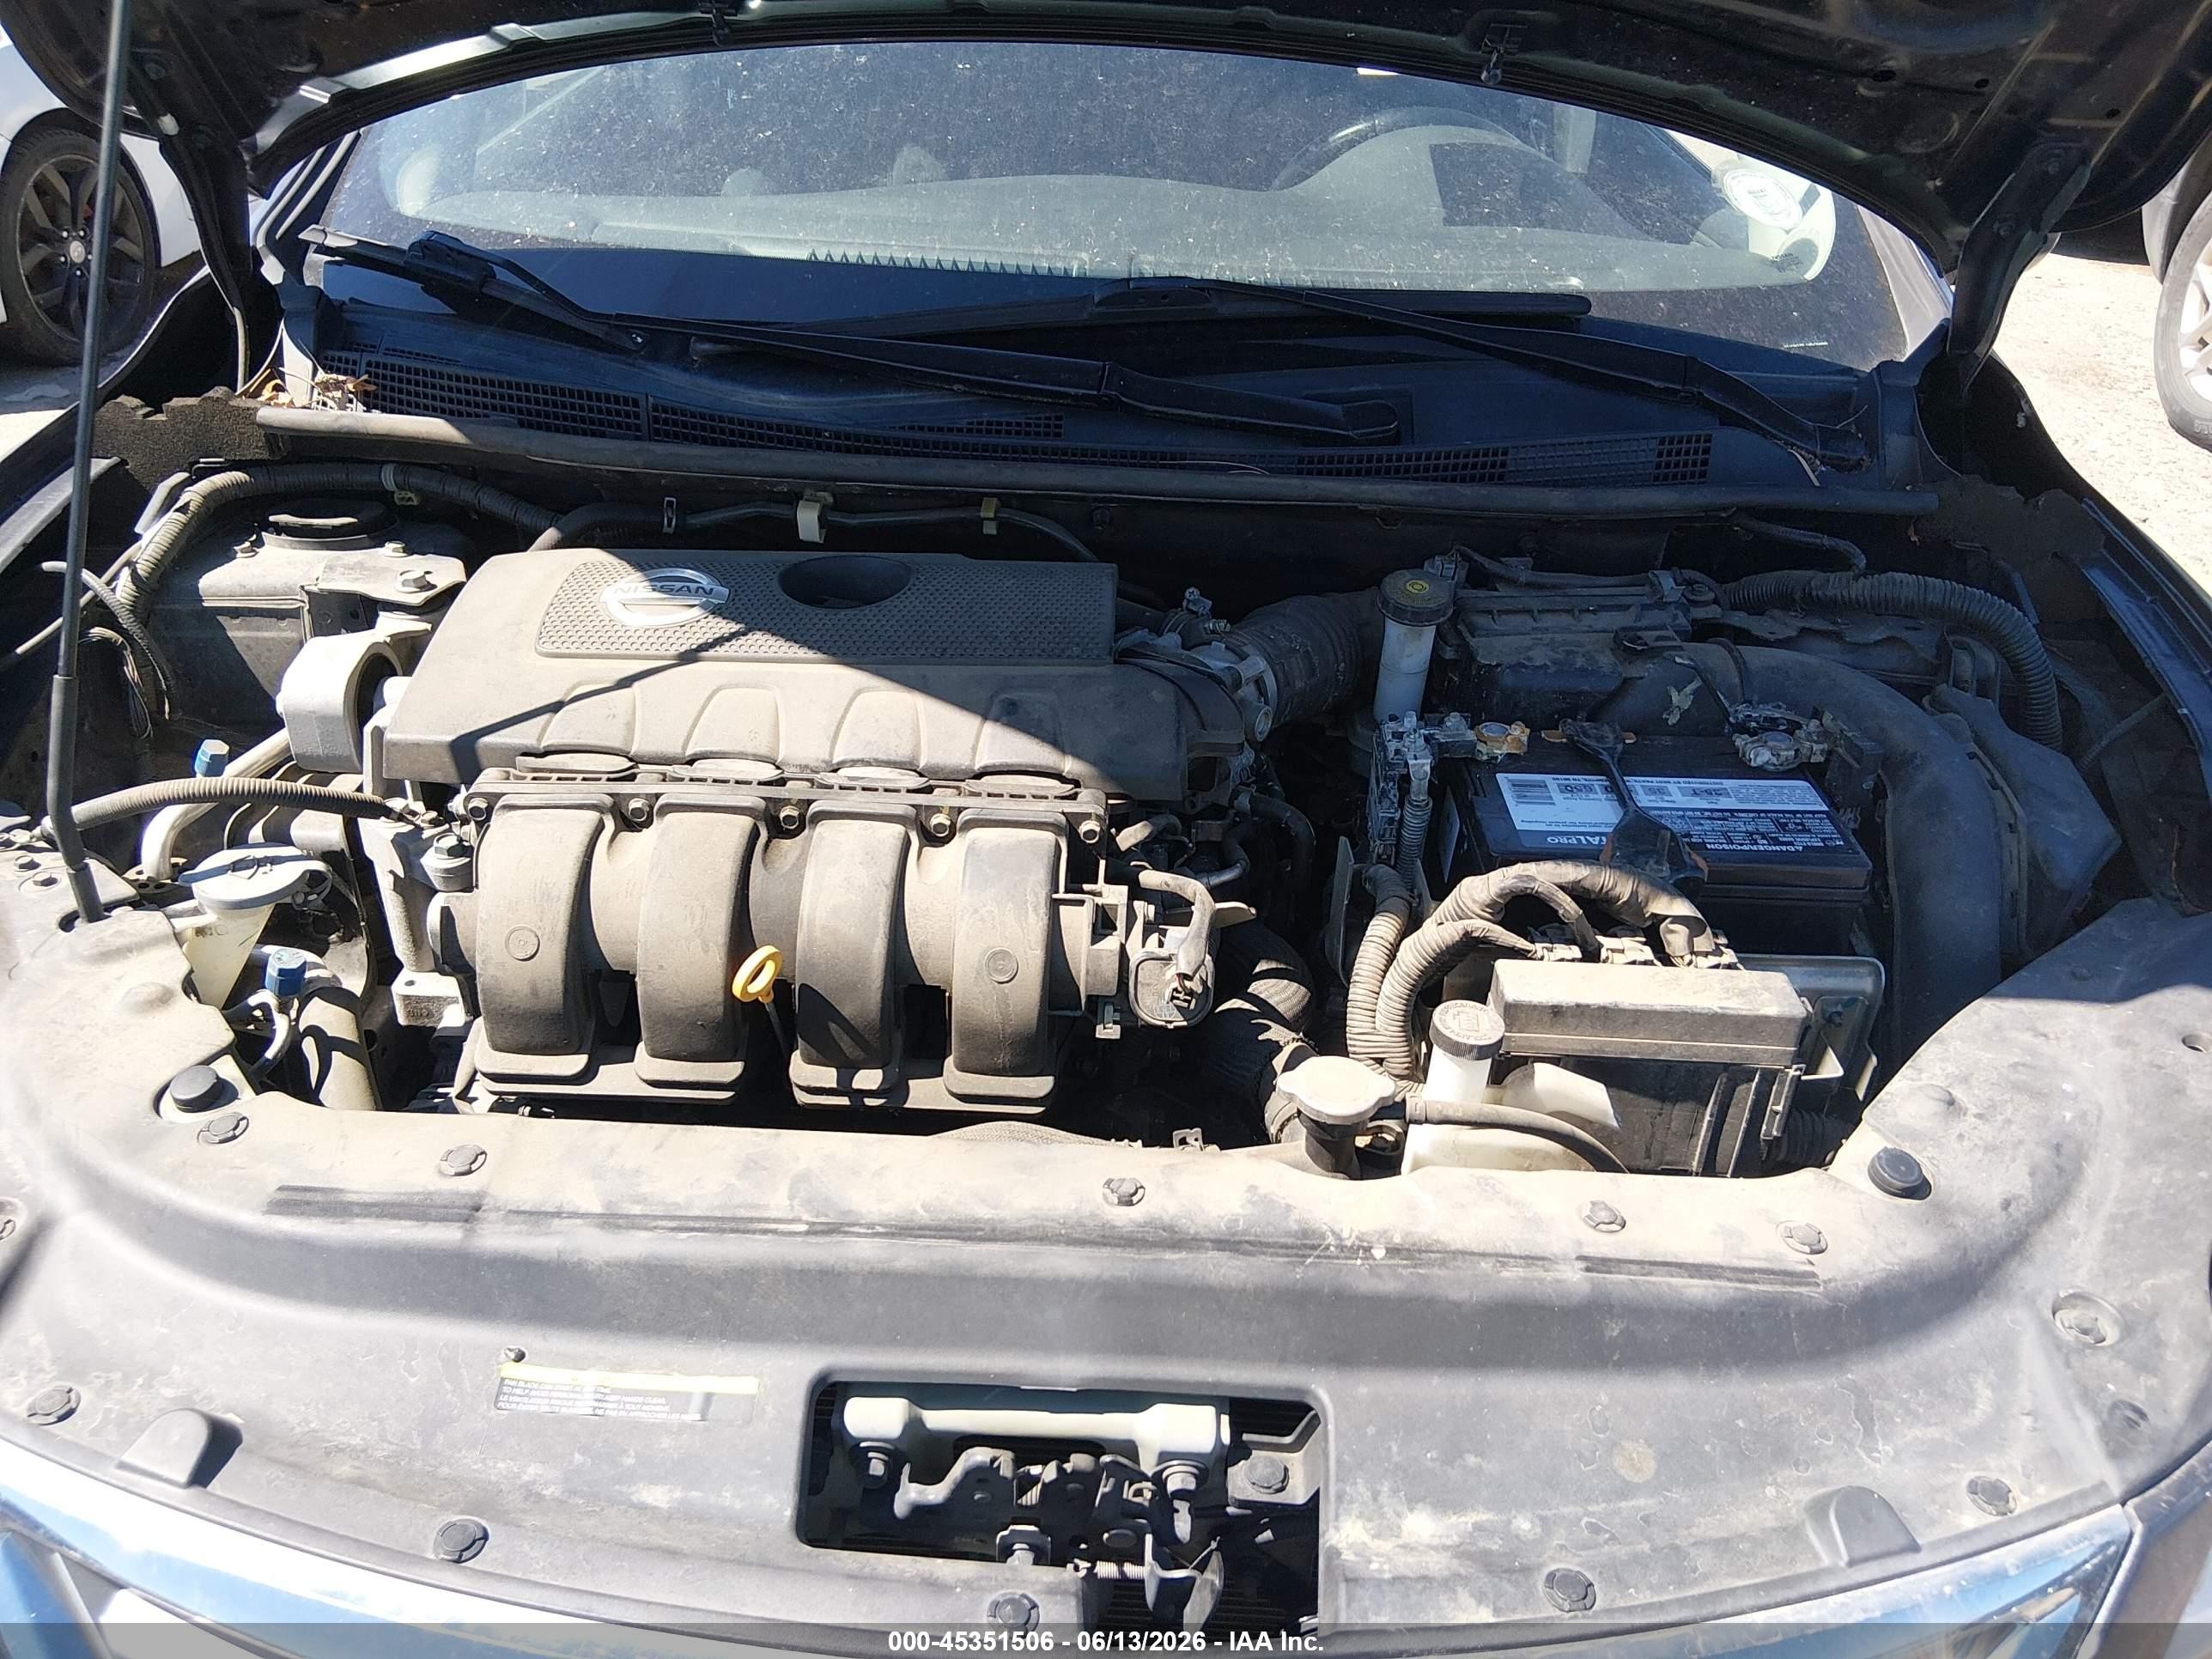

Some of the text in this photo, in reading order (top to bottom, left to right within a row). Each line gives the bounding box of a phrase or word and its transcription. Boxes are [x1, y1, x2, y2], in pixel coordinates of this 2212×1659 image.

[613, 584, 714, 596] NISSAN
[1547, 836, 1607, 845] TALPRO
[1705, 843, 1796, 852] DANGER/POISON
